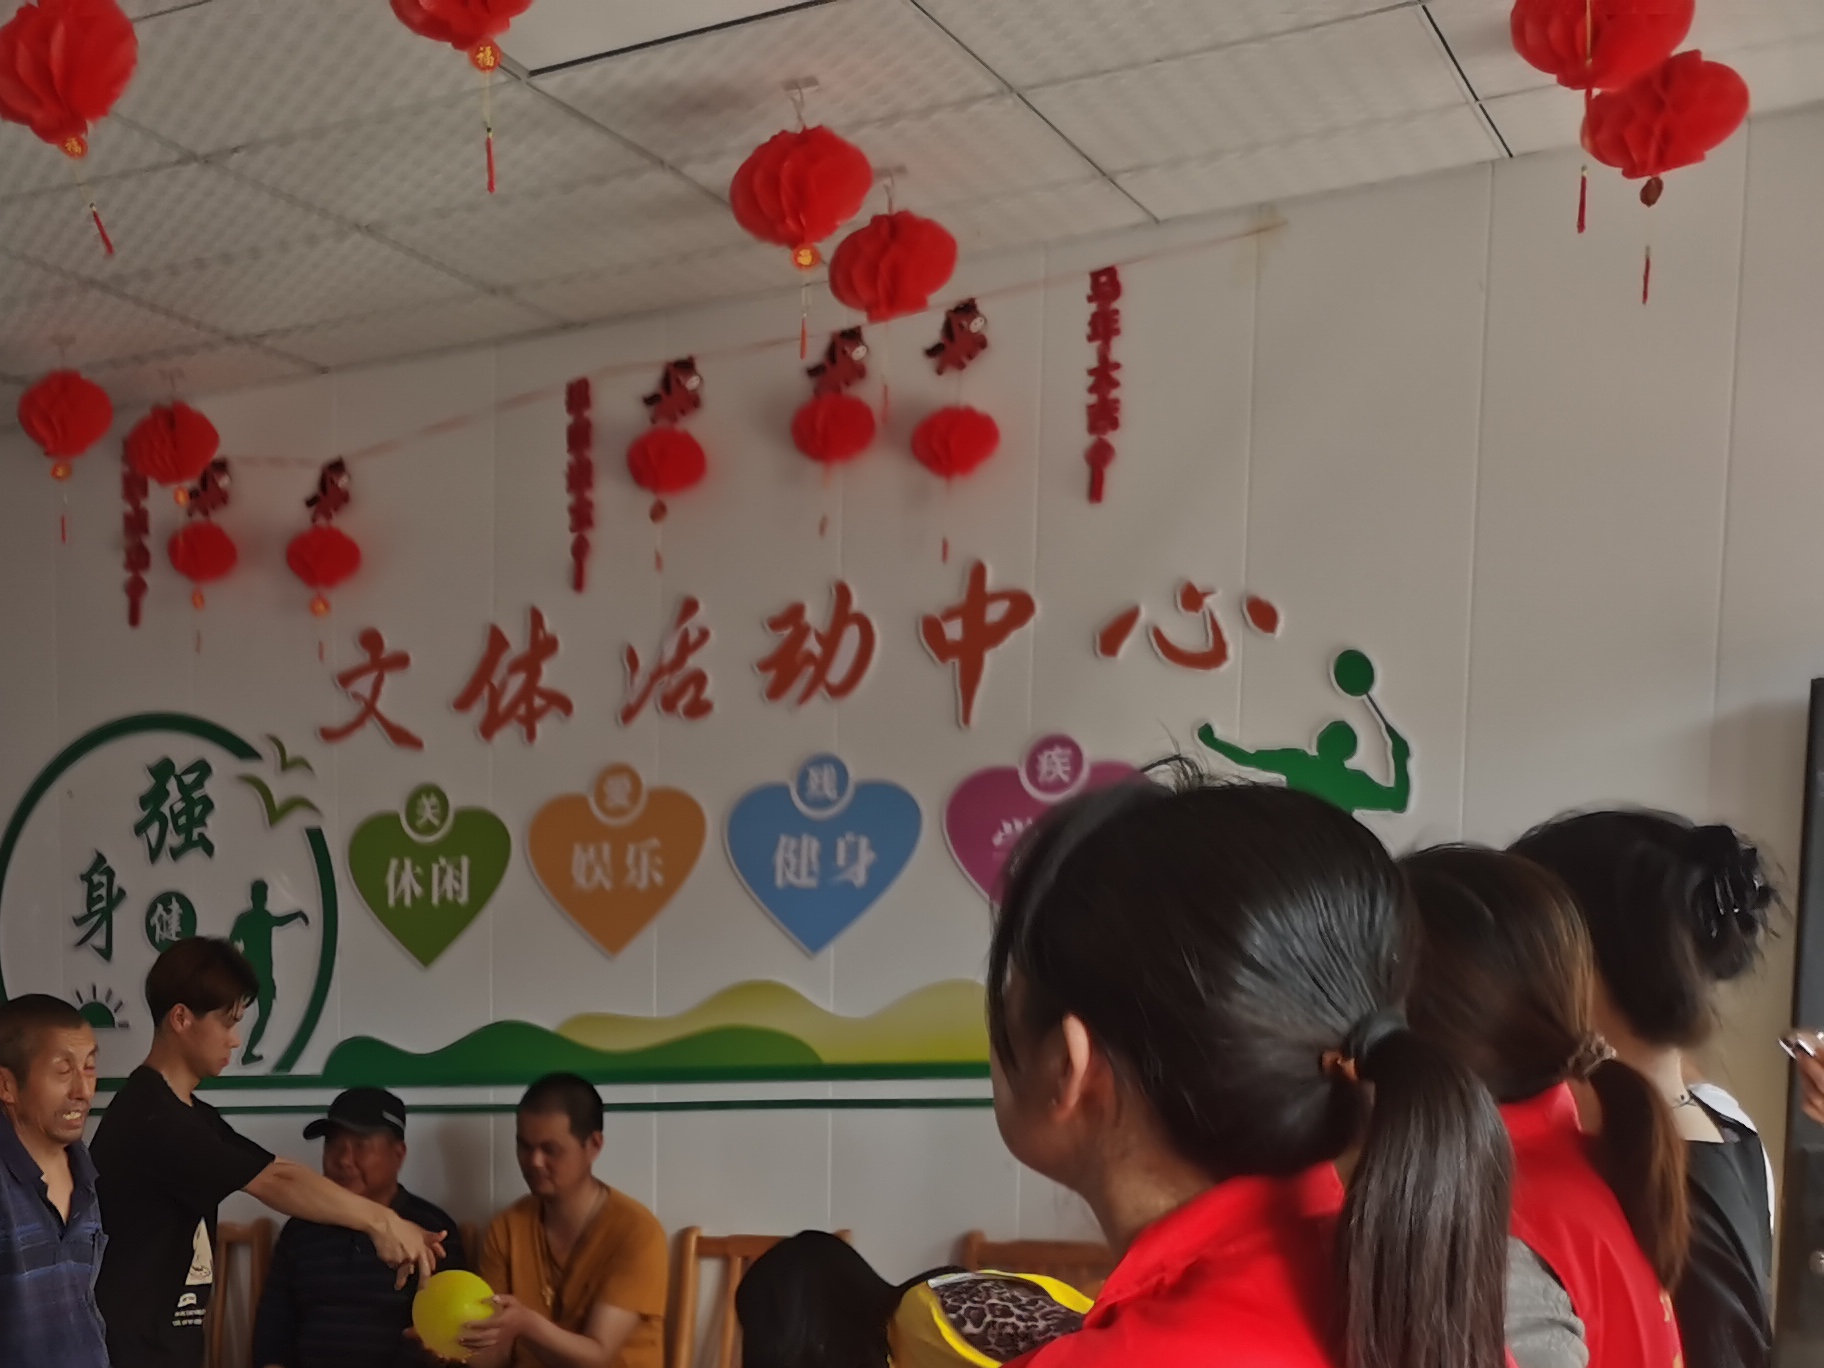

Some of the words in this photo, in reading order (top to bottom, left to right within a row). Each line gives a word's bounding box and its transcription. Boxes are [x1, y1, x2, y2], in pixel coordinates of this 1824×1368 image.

[318, 562, 1280, 752] 文体活动中心
[1037, 744, 1073, 784] 疾
[134, 757, 214, 864] 强
[415, 792, 442, 829] 关
[385, 854, 472, 909] 休闲
[571, 837, 665, 893] 娱乐
[773, 831, 876, 890] 健身
[72, 849, 127, 963] 身
[150, 896, 184, 943] 健
